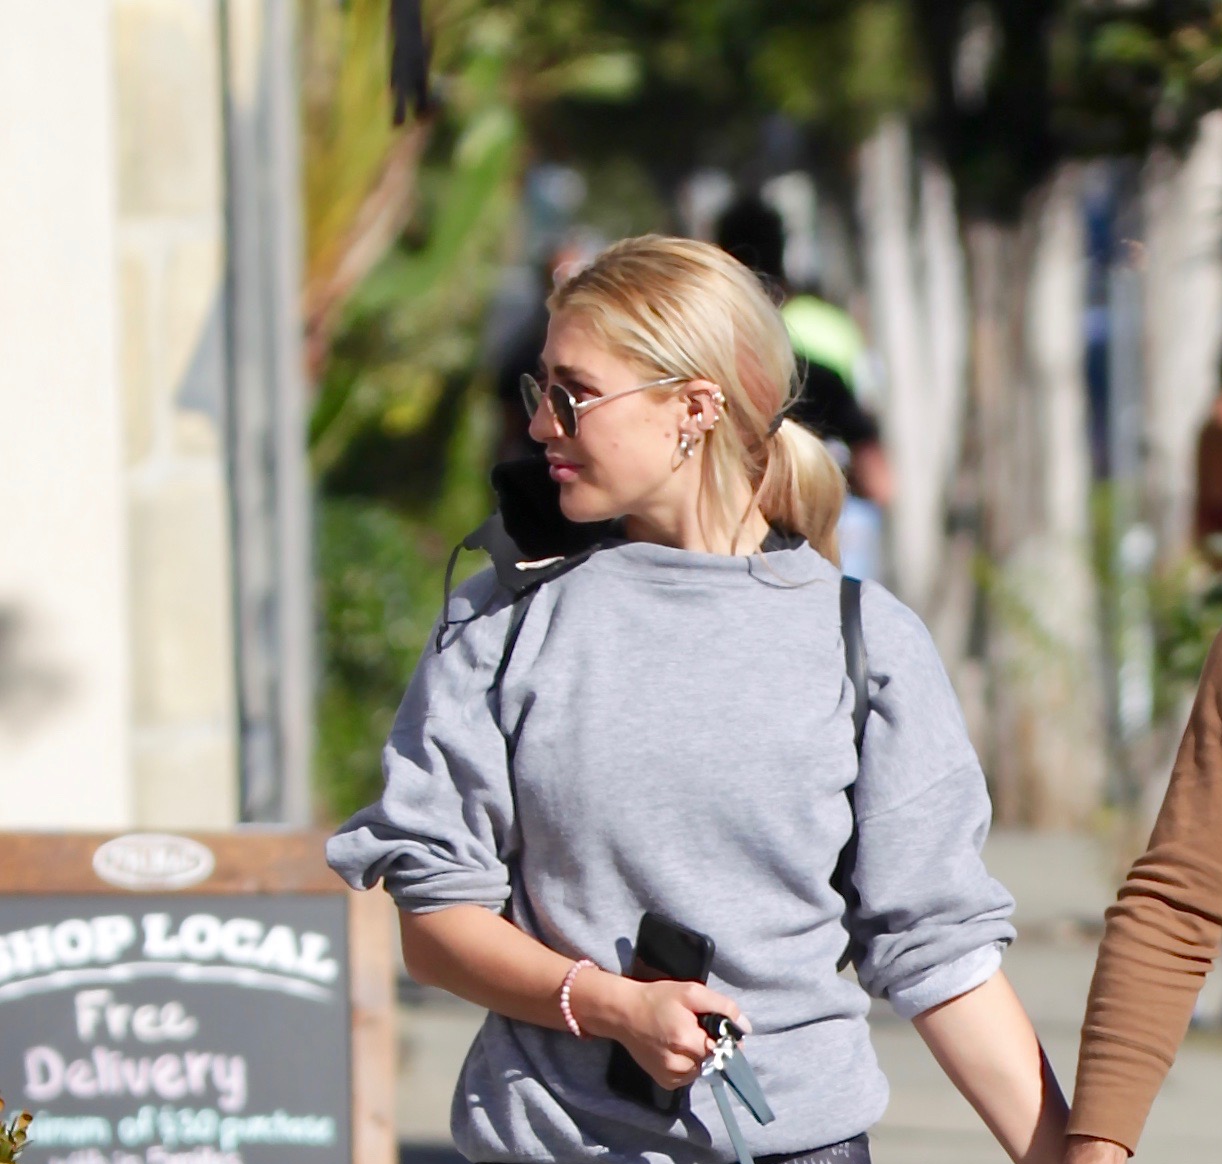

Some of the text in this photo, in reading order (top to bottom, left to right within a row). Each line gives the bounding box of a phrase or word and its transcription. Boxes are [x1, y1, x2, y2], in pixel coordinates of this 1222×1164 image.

[142, 913, 338, 984] LOCAL
[74, 988, 198, 1043] Free
[24, 1045, 248, 1113] Delivery
[117, 1105, 157, 1146] of
